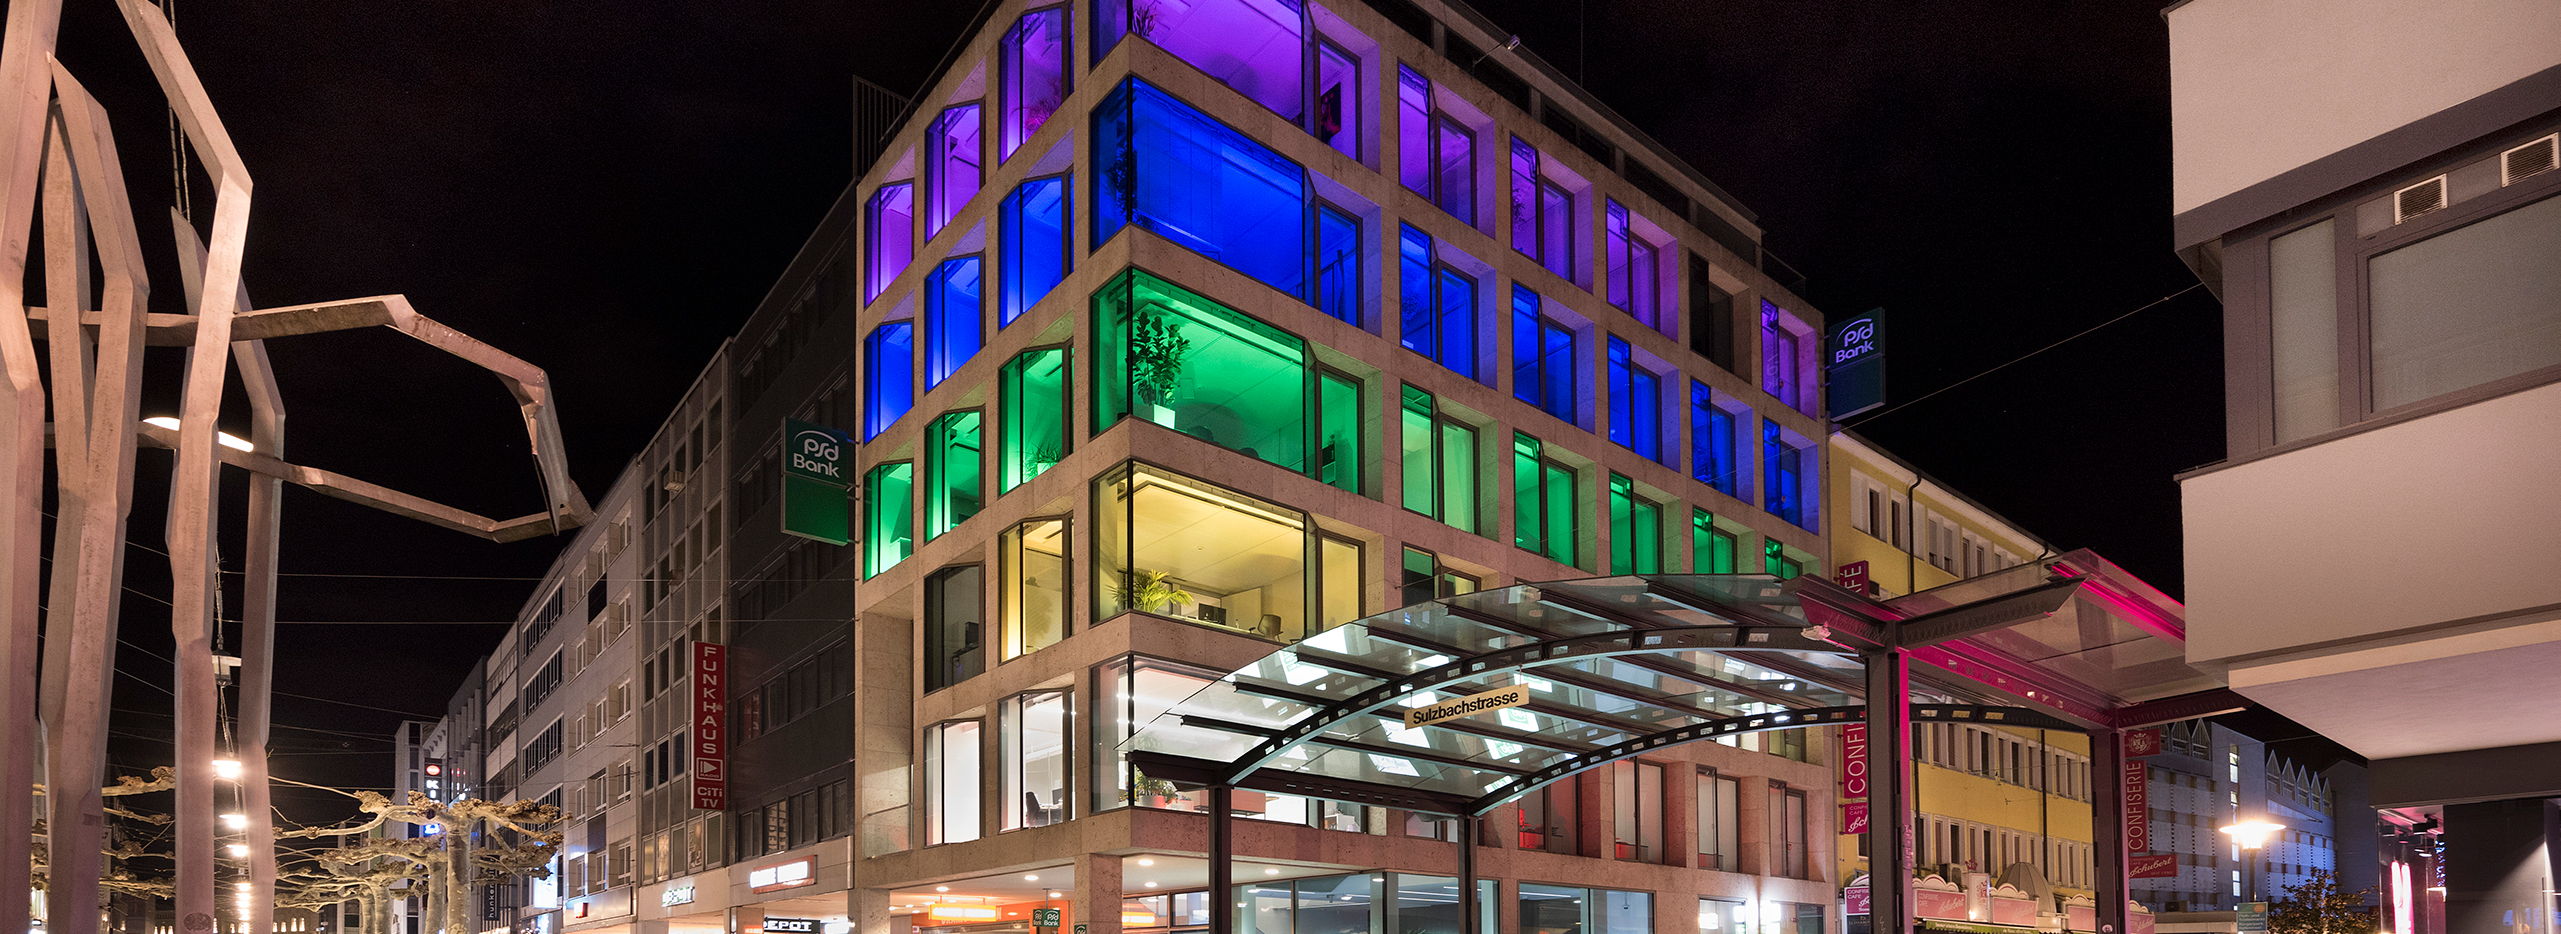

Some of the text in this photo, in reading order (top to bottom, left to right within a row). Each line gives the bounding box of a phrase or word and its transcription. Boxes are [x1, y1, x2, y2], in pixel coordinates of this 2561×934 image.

[1844, 322, 1874, 348] psd
[1835, 340, 1874, 364] Bank
[804, 438, 839, 461] psd
[793, 453, 840, 478] Bank
[701, 646, 717, 754] FUNKHAUS
[1413, 692, 1519, 725] Sulzbachstrasse
[1847, 723, 1866, 794] CONFI
[701, 798, 718, 808] TV
[2126, 762, 2144, 850] CONFISERIE
[2128, 856, 2173, 878] Schubert
